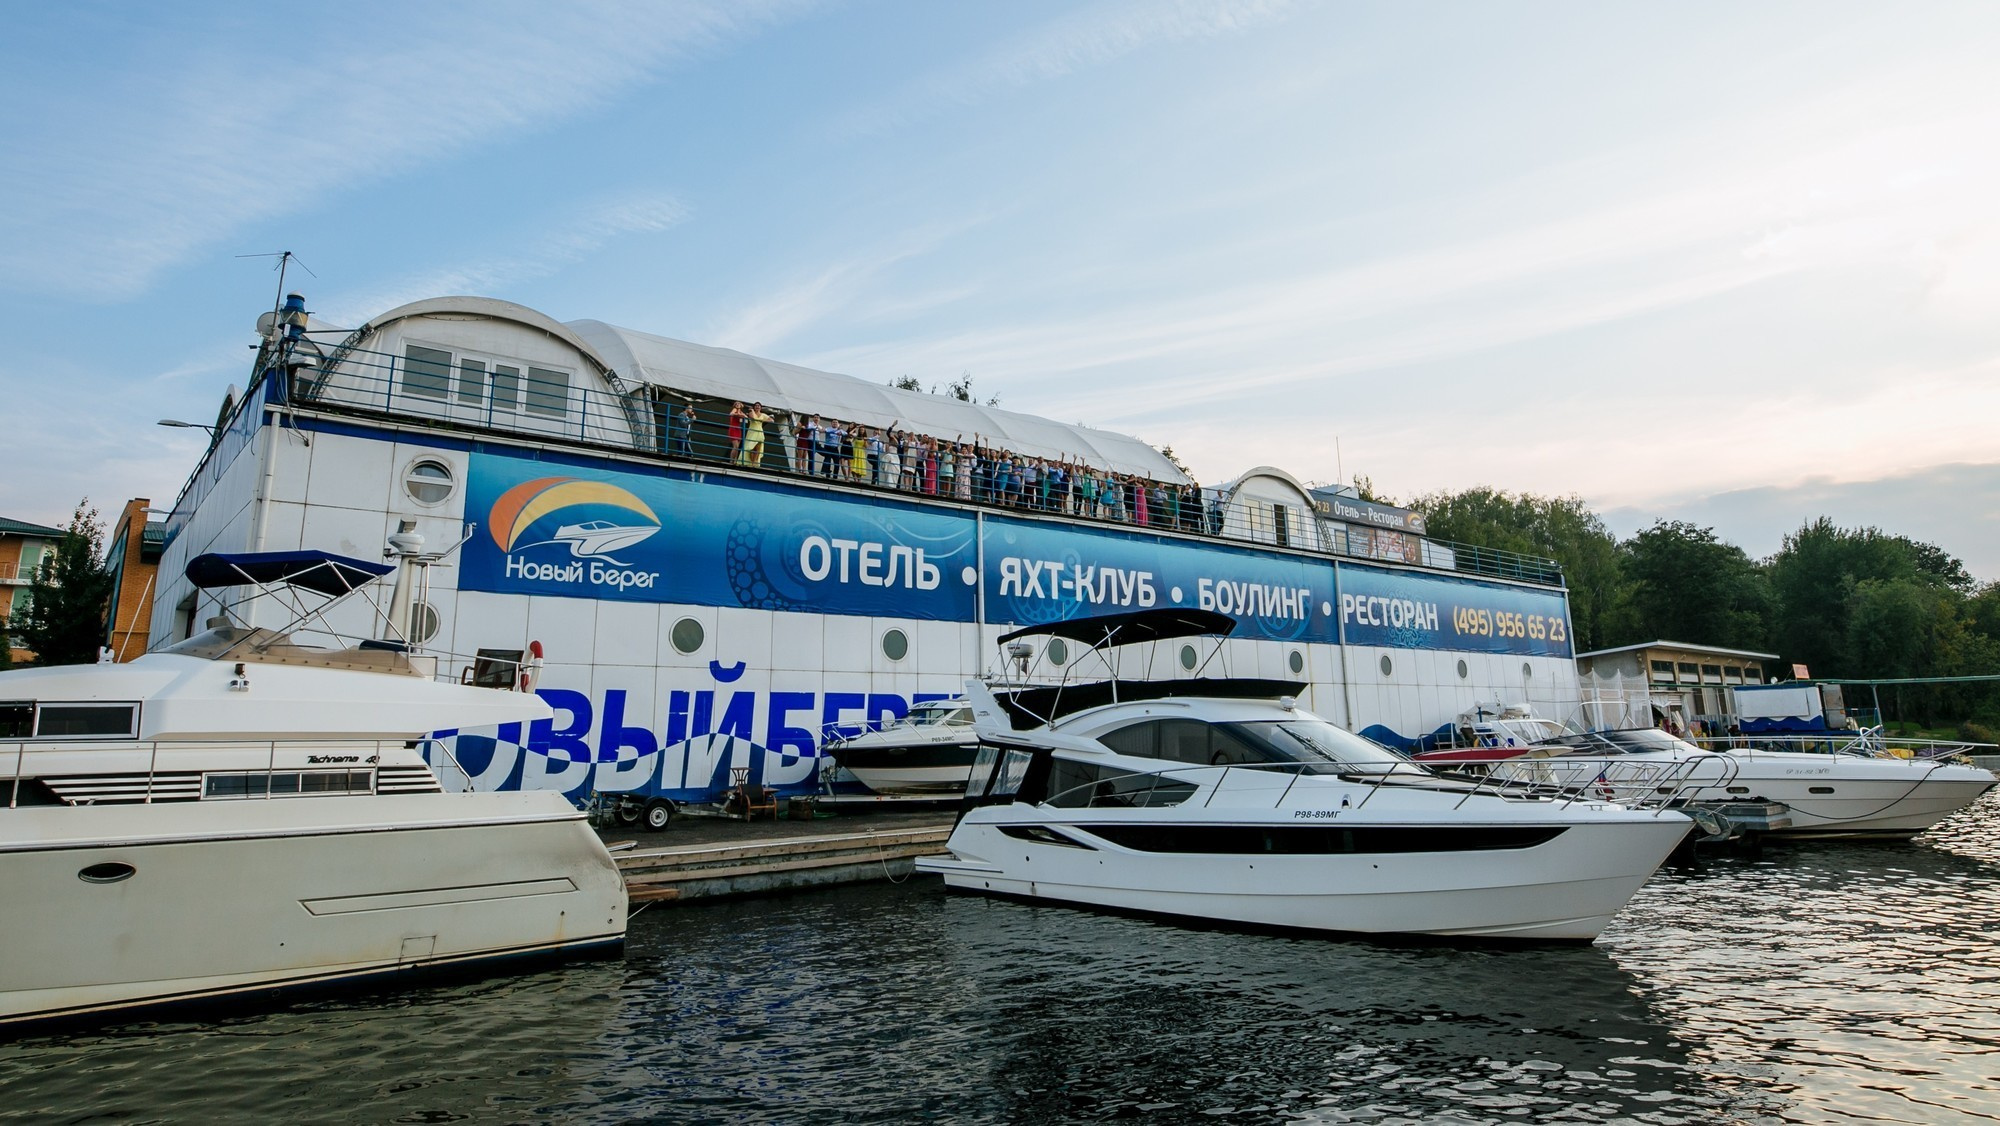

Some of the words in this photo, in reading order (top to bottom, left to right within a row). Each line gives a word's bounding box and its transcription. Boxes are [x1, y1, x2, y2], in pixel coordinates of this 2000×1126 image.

[1322, 502, 1330, 513] 23
[1334, 500, 1359, 518] Отель
[1368, 507, 1404, 528] Ресторан
[505, 554, 584, 583] Новый
[589, 562, 660, 592] Берег
[800, 535, 941, 590] ОТЕЛЬ
[1000, 556, 1156, 608] ЯХТ-КЛУБ
[1198, 577, 1311, 620] БОУЛИНГ
[1342, 593, 1439, 631] РЕСТОРАН
[1453, 605, 1493, 638] (495)
[1496, 610, 1525, 638] 956
[1527, 614, 1546, 640] 65
[1548, 617, 1566, 642] 23
[1294, 810, 1341, 819] Р98-89МГ
